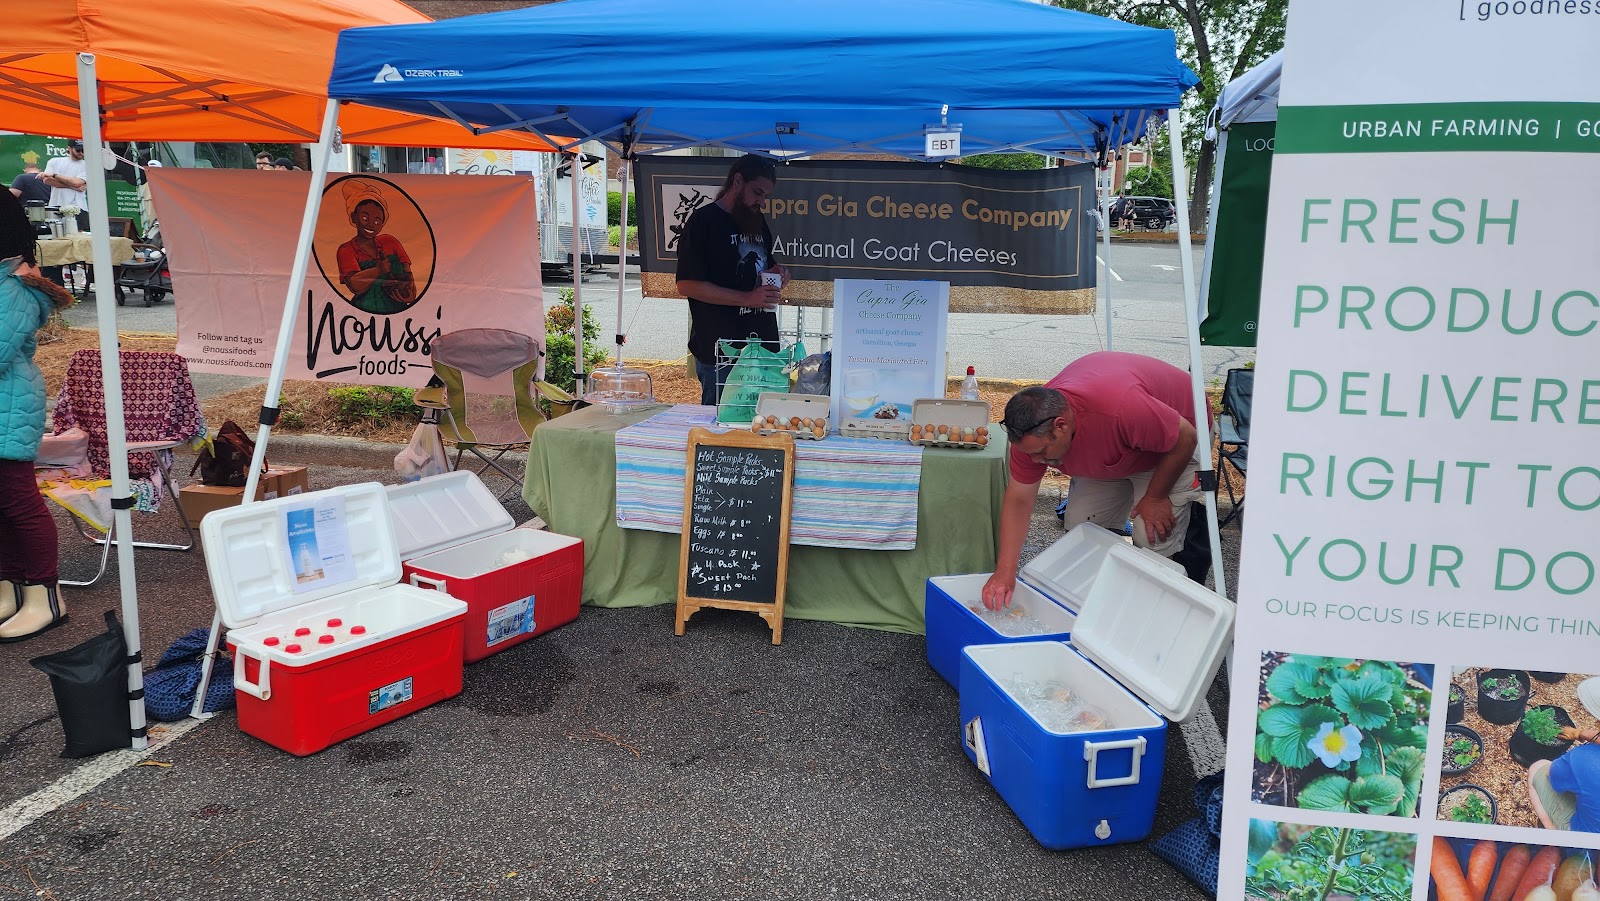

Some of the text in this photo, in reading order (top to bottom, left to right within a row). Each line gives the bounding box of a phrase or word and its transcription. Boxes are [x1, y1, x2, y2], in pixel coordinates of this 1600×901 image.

[404, 69, 436, 78] OZARK
[1343, 121, 1421, 138] URBAN
[1431, 119, 1540, 137] FARMING
[931, 139, 956, 150] EBT
[759, 193, 1073, 232] apra Gia Cheese Company
[1300, 198, 1519, 245] FRESH
[771, 235, 855, 259] Artisanal
[863, 238, 921, 262] Goat
[928, 240, 1018, 267] Cheeses
[885, 283, 900, 291] The
[857, 288, 928, 311] Capra Gia
[858, 310, 923, 321] Cheese Company
[1293, 285, 1600, 337] PRODUC
[197, 333, 222, 341] Follow
[240, 336, 253, 345] tag
[202, 345, 257, 356] @noussifoods
[359, 354, 406, 376] foods
[1286, 369, 1600, 425] DELIVERE
[698, 450, 763, 467] Hot Sample Packs
[696, 463, 716, 472] Sweet
[714, 473, 738, 487] Sample
[740, 475, 758, 486] Packs
[1280, 452, 1490, 505] RIGHT
[695, 484, 714, 495] Plain
[693, 502, 713, 513] Single
[694, 513, 711, 523] Raw
[711, 516, 727, 526] Milk
[693, 526, 712, 539] Eggs
[691, 542, 725, 556] Tuscano
[1272, 533, 1595, 596] YOUR DO
[1265, 598, 1318, 619] OUR
[1324, 603, 1404, 625] FOCUS
[1410, 609, 1430, 626] IS
[1436, 610, 1539, 633] KEEPING
